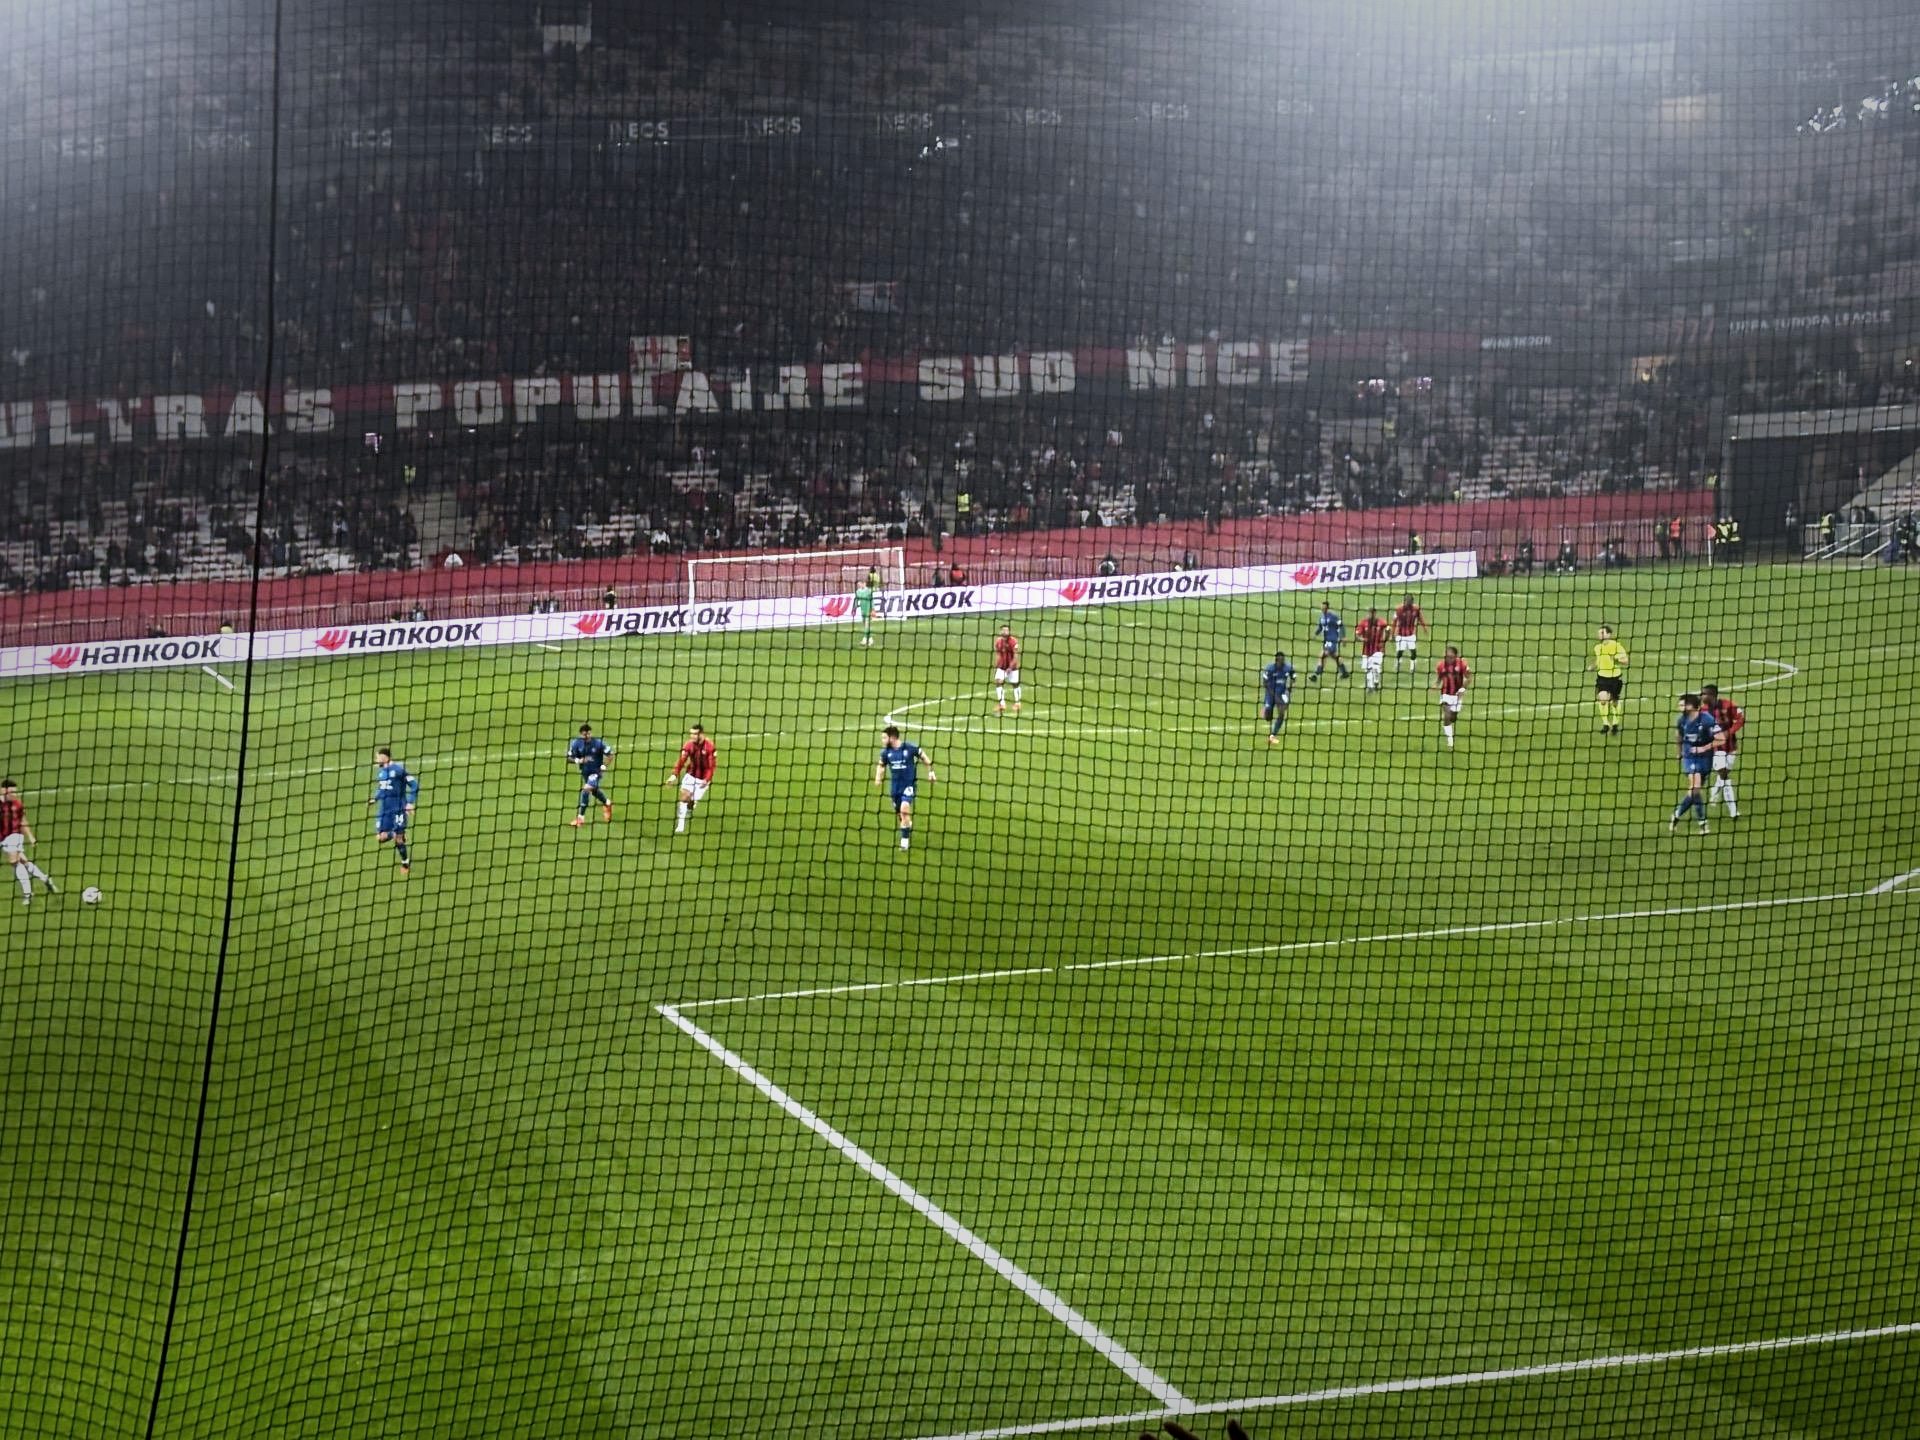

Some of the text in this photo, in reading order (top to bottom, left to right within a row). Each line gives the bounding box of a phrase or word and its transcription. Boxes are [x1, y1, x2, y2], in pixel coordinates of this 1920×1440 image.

[0, 389, 335, 448] ULTRAS
[394, 362, 864, 428] POPULAIRE
[1126, 341, 1309, 391] NICE
